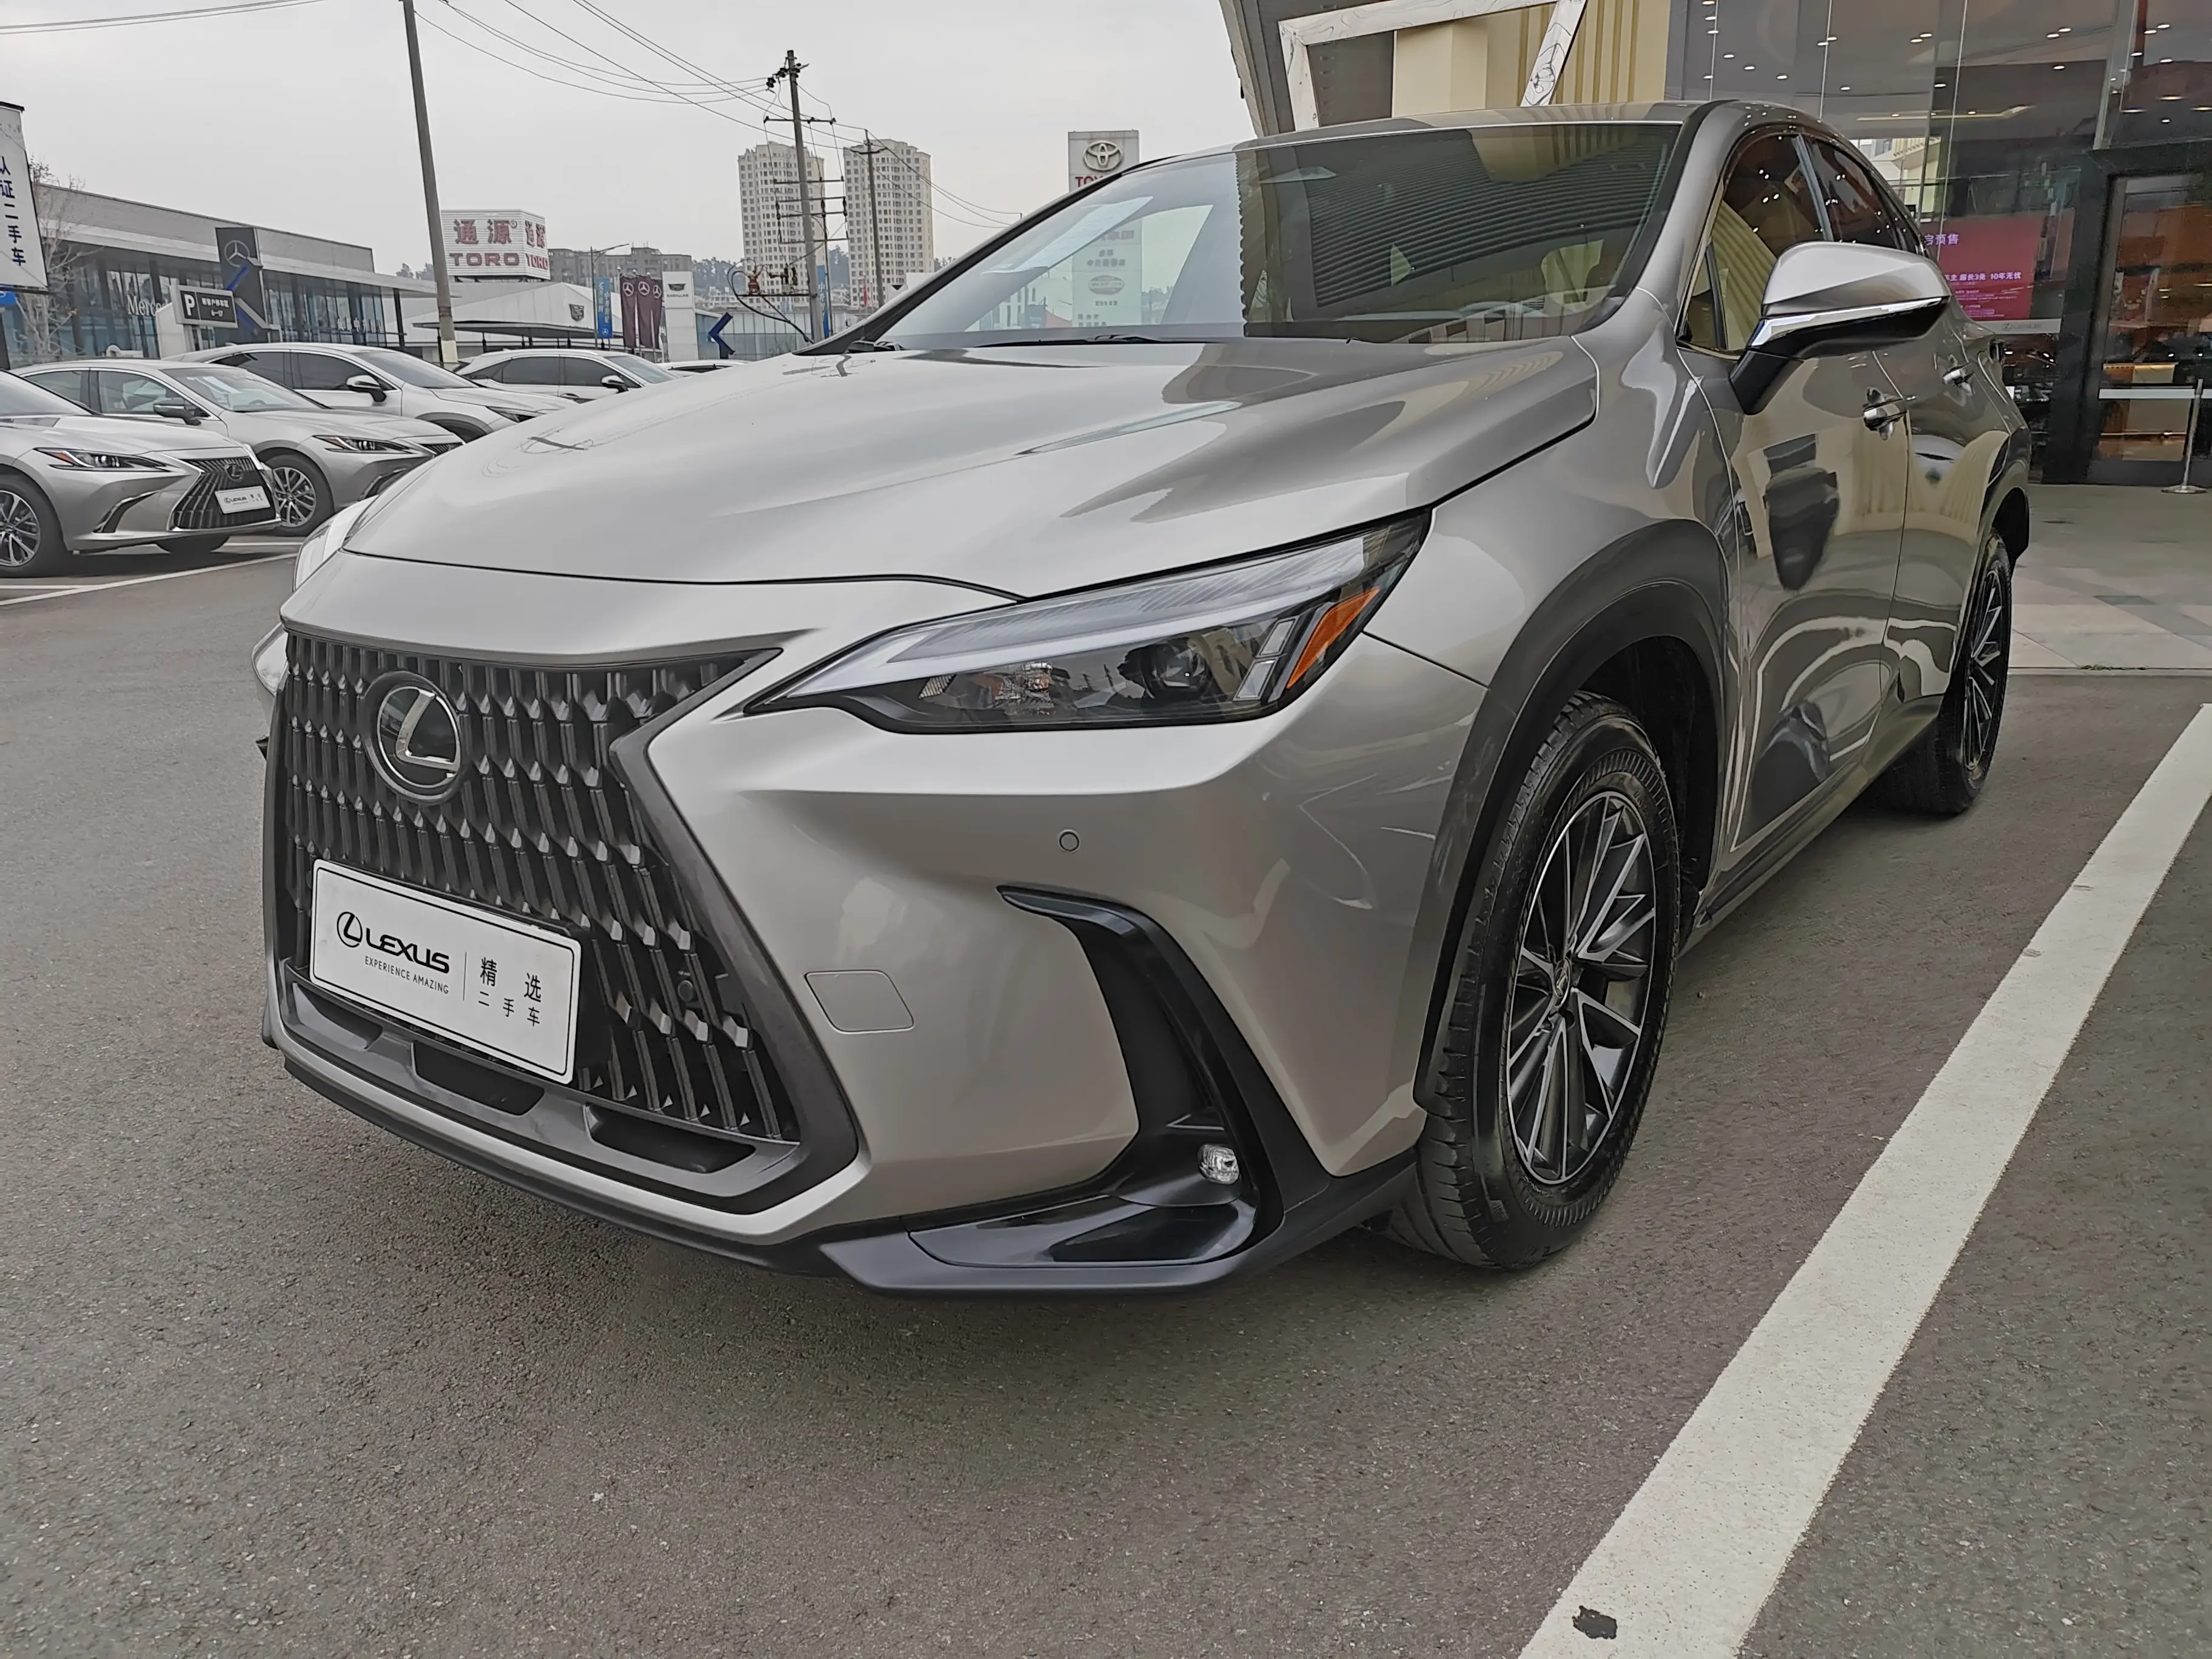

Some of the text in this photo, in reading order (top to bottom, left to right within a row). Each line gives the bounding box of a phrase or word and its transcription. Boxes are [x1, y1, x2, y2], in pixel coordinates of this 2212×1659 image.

[449, 253, 520, 267] TORO
[526, 253, 548, 270] TORO
[184, 294, 195, 316] P
[366, 927, 450, 974] LEXUS
[364, 955, 449, 994] EXPERIENCE AMAZING
[478, 991, 540, 1027] 二手车
